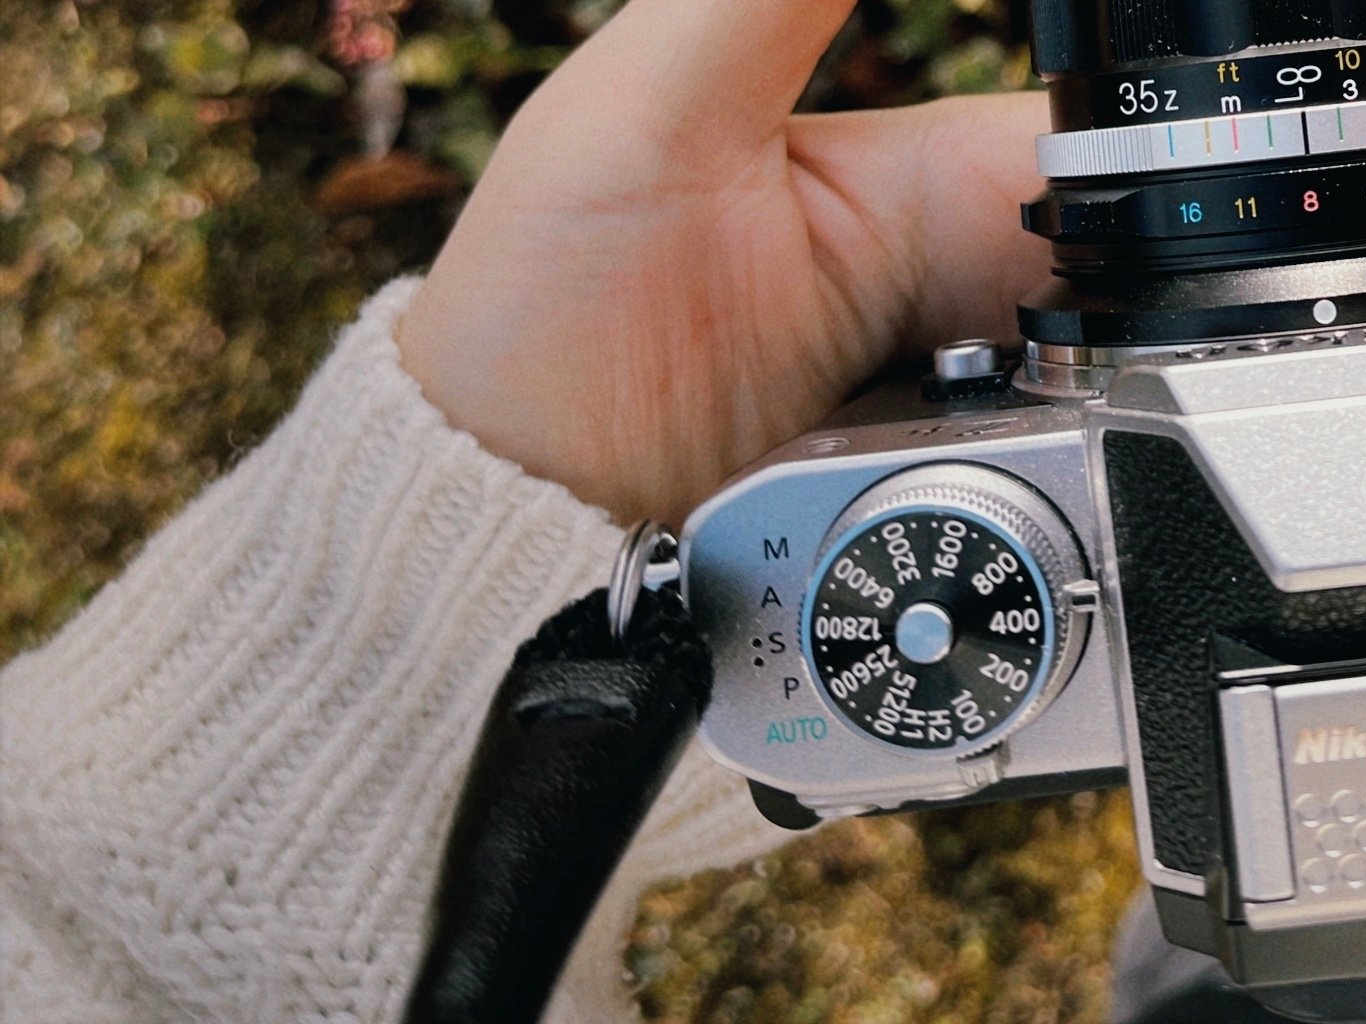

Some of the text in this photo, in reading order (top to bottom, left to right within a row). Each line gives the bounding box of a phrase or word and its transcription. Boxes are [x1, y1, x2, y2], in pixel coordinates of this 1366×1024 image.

[1216, 61, 1240, 84] ft
[1335, 48, 1361, 71] 10
[1220, 94, 1242, 114] m
[1342, 79, 1359, 100] 3
[1178, 202, 1203, 224] 16
[1234, 196, 1257, 219] 11
[1303, 190, 1319, 212] 8
[763, 537, 790, 561] M
[881, 522, 922, 585] 3200
[931, 520, 967, 578] 1600
[833, 557, 895, 609] 6400
[971, 552, 1018, 595] 800
[760, 585, 782, 608] A
[815, 616, 882, 642] 12800
[989, 608, 1041, 635] 400
[768, 631, 786, 654] S
[783, 677, 800, 700] P
[829, 644, 899, 699] 25600
[978, 652, 1029, 693] 200
[870, 670, 917, 736] 51200
[950, 688, 986, 735] 100
[766, 715, 828, 745] AUTO
[900, 708, 926, 739] H1
[925, 709, 952, 742] H2
